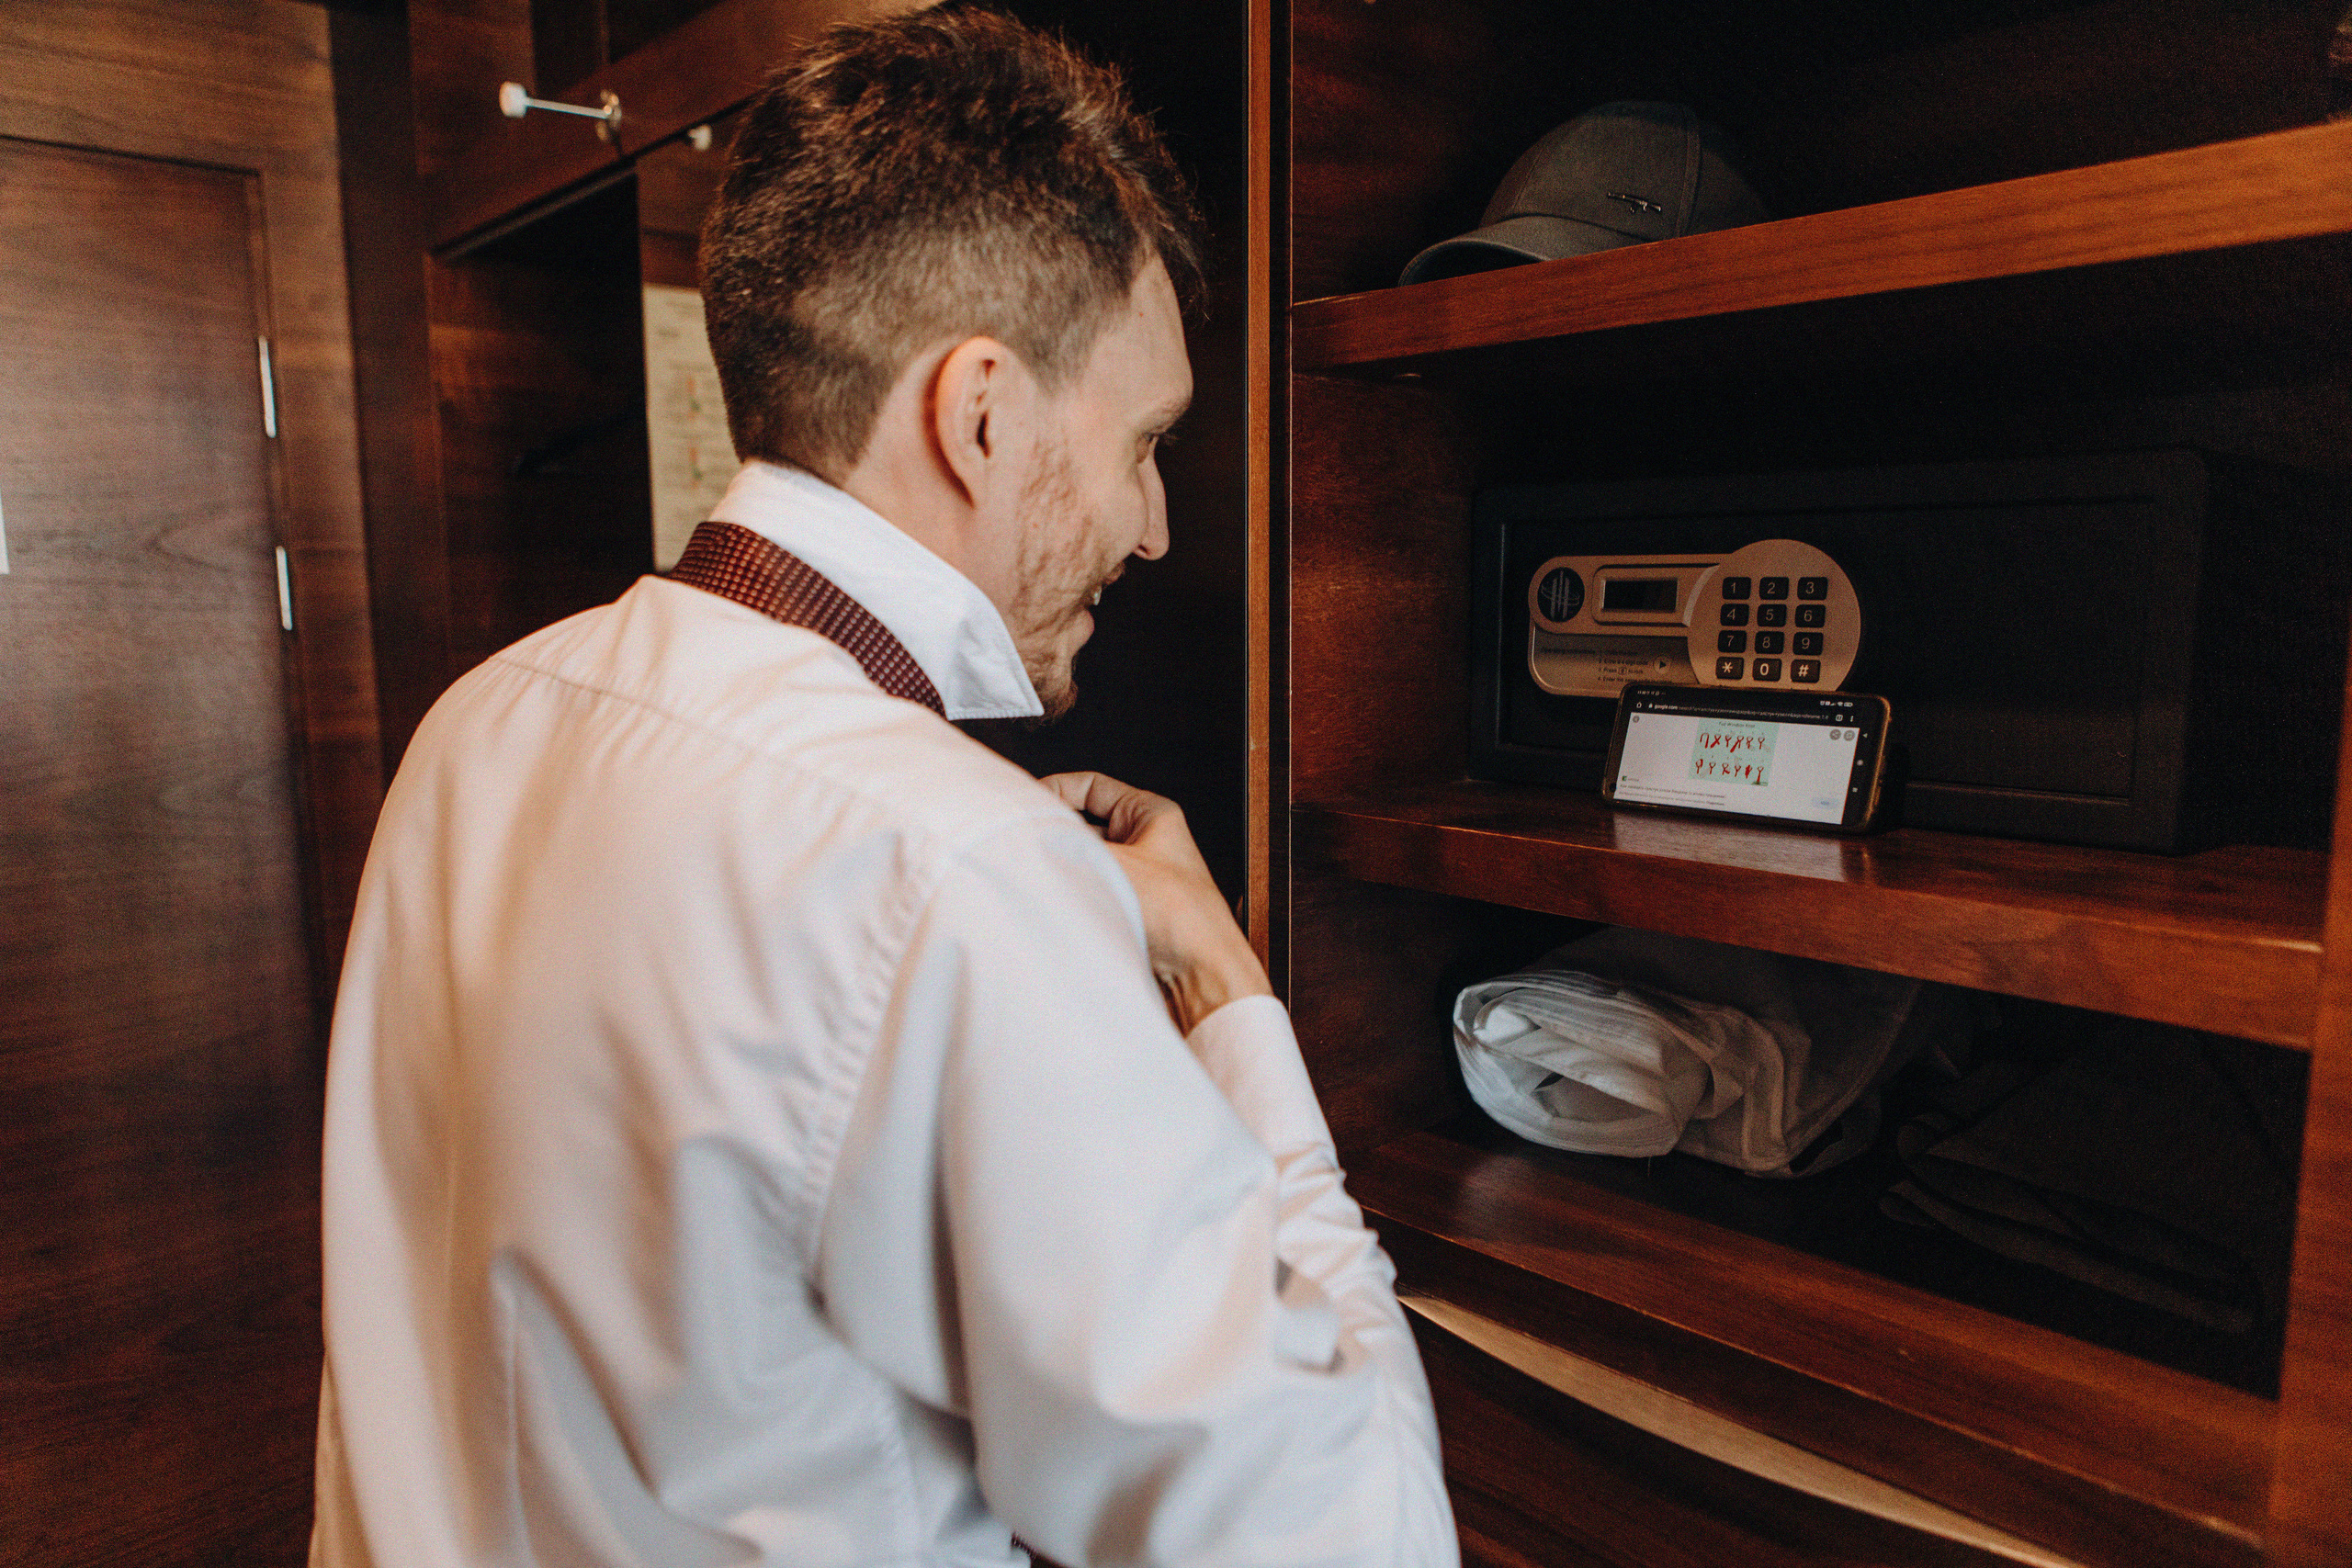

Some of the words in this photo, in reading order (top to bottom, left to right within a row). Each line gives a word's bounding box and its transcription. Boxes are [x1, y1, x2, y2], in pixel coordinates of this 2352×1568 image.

[1767, 581, 1776, 594] 2
[1805, 581, 1815, 594] 3
[1726, 608, 1736, 620] 4
[1765, 608, 1774, 621] 5
[1804, 609, 1813, 622] 6
[1727, 635, 1735, 648] 7
[1762, 636, 1770, 649] 8
[1801, 637, 1811, 649] 9
[1759, 662, 1770, 676] 0
[1798, 664, 1809, 677] #
